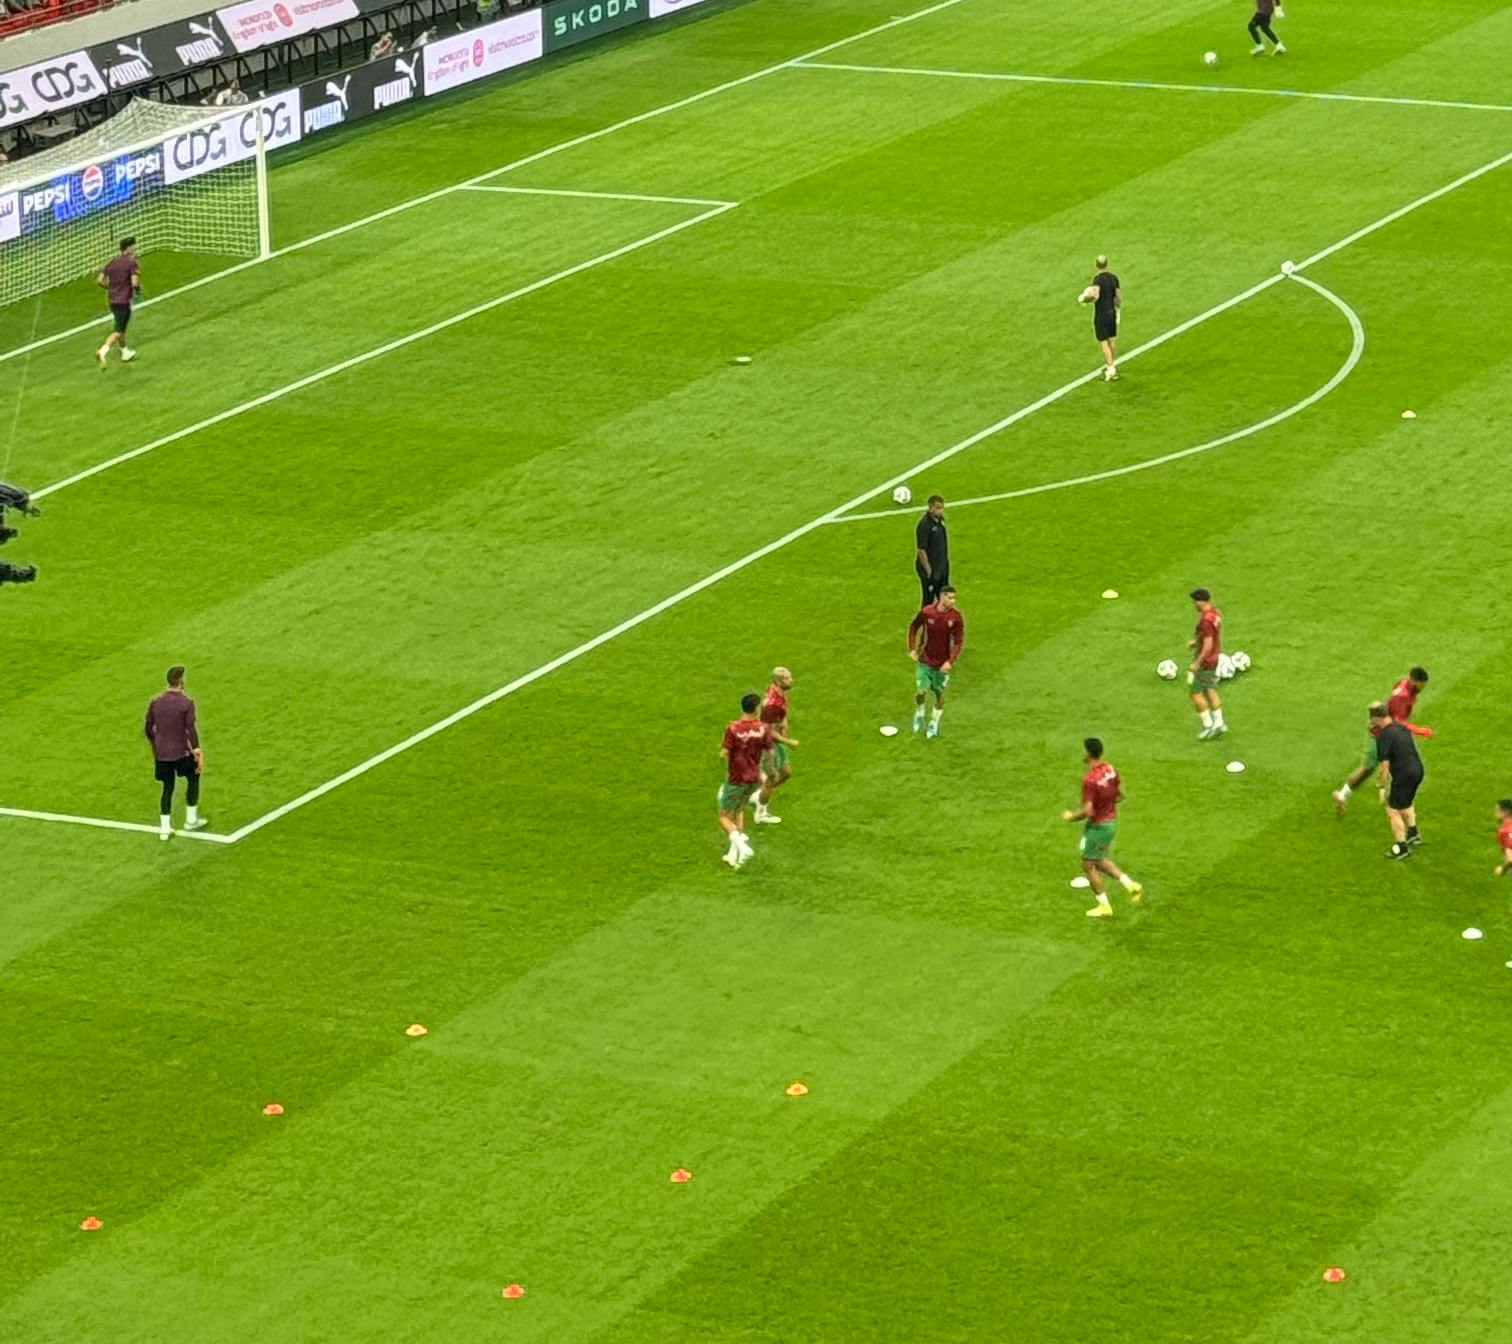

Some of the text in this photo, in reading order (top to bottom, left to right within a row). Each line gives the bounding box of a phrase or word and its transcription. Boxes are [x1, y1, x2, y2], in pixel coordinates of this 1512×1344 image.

[175, 37, 221, 66] PUMA
[31, 62, 96, 103] CDG
[373, 76, 412, 111] PUMA
[173, 122, 227, 171] CDG
[23, 181, 71, 214] PEPSI
[115, 152, 161, 180] PEPSI
